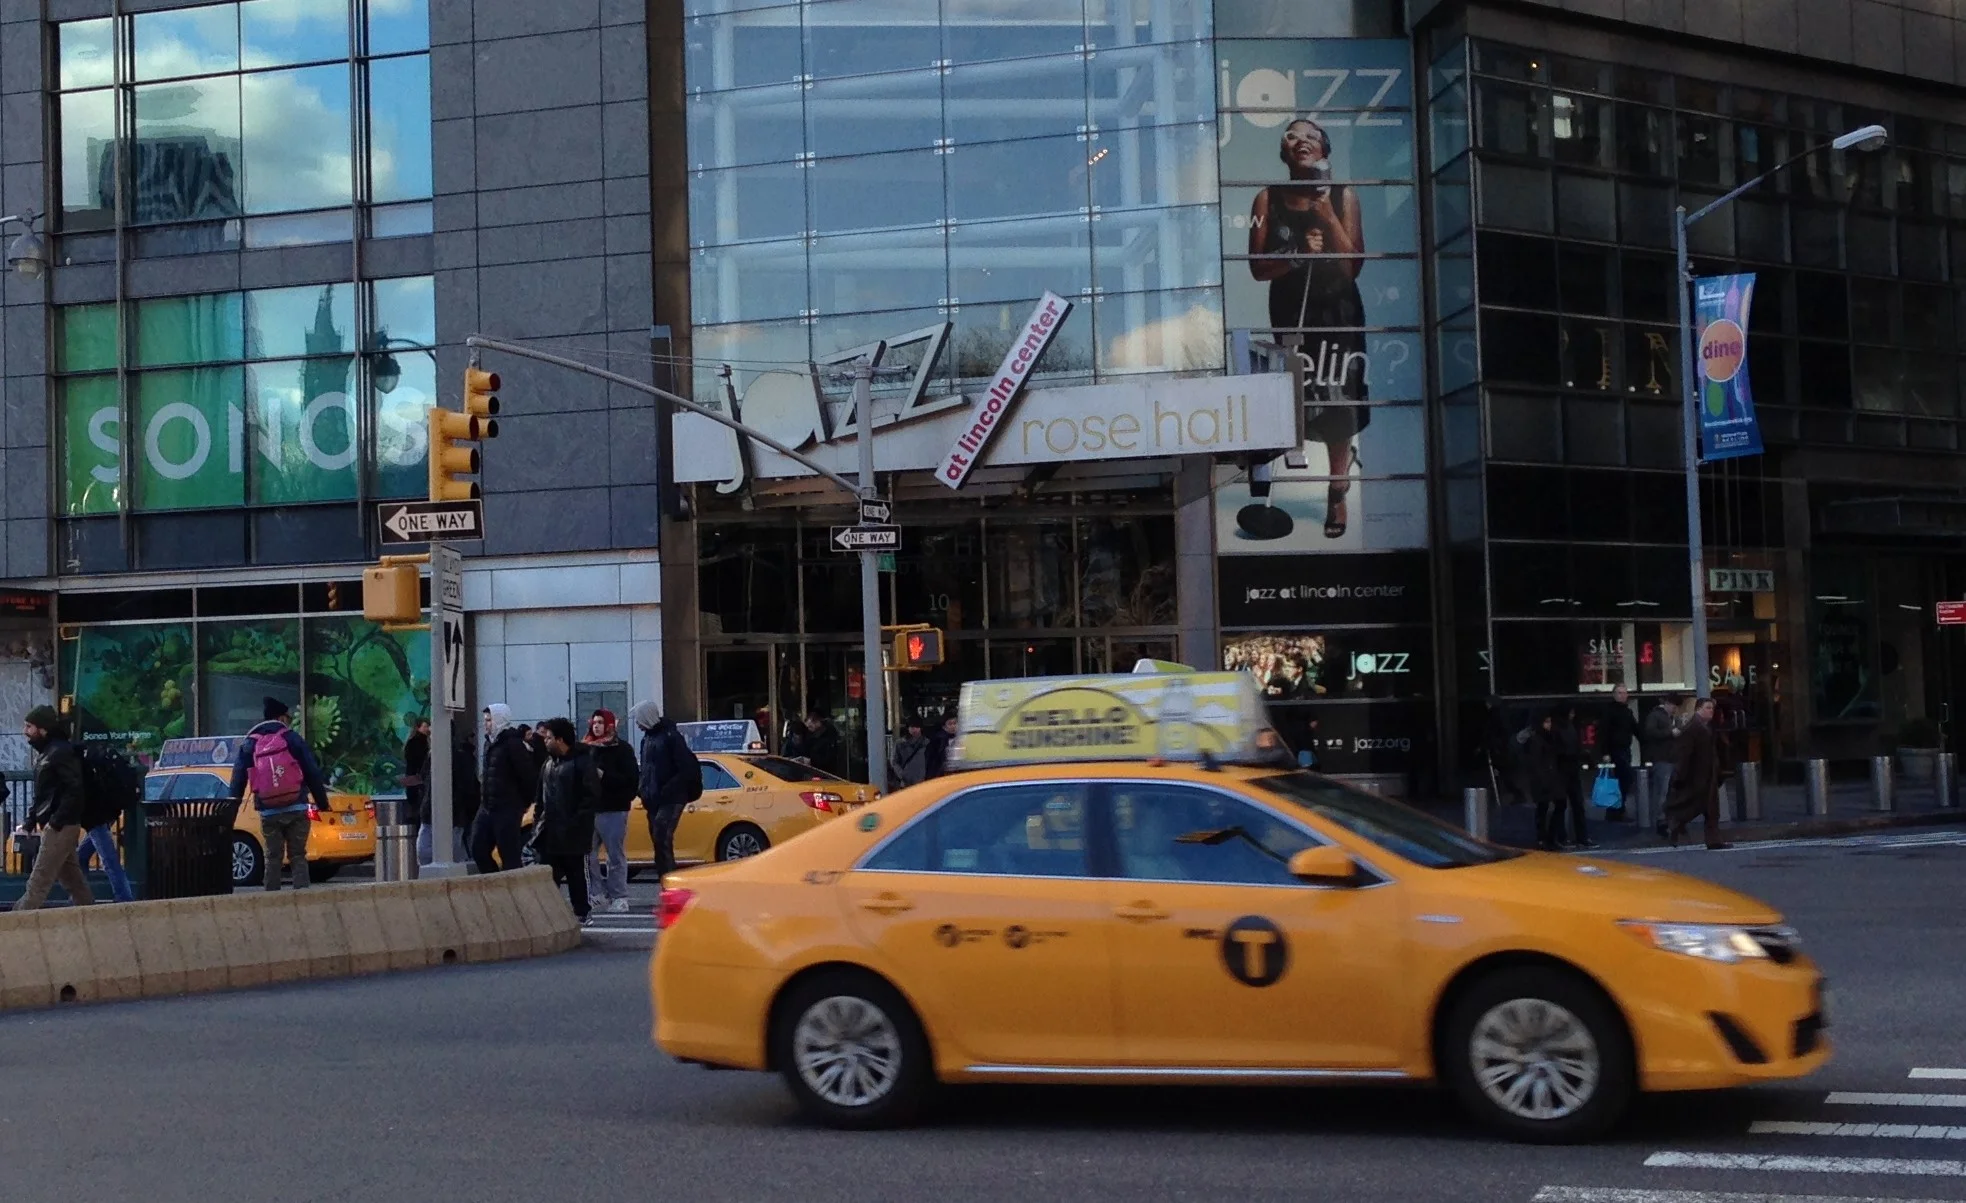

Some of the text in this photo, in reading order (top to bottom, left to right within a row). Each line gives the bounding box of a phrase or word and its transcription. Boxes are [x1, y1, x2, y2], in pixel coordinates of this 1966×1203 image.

[1219, 58, 1403, 147] jazz
[1702, 340, 1741, 360] dine
[946, 451, 968, 481] at
[957, 376, 1016, 455] lincoln
[1010, 299, 1060, 374] center
[715, 322, 963, 495] jazz
[87, 385, 429, 483] SONOS
[1022, 394, 1248, 454] rose hall
[866, 506, 875, 517] ONE
[398, 513, 467, 531] ONE WAY
[843, 532, 891, 543] ONE WAY
[1715, 570, 1771, 589] PINK
[929, 593, 950, 611] 10
[1245, 584, 1405, 604] jazz at lincoln center
[1588, 638, 1625, 654] SALE
[1347, 650, 1411, 681] jazz
[1019, 706, 1128, 727] HELLO
[1353, 736, 1411, 754] jazz.org
[1230, 928, 1278, 979] T
